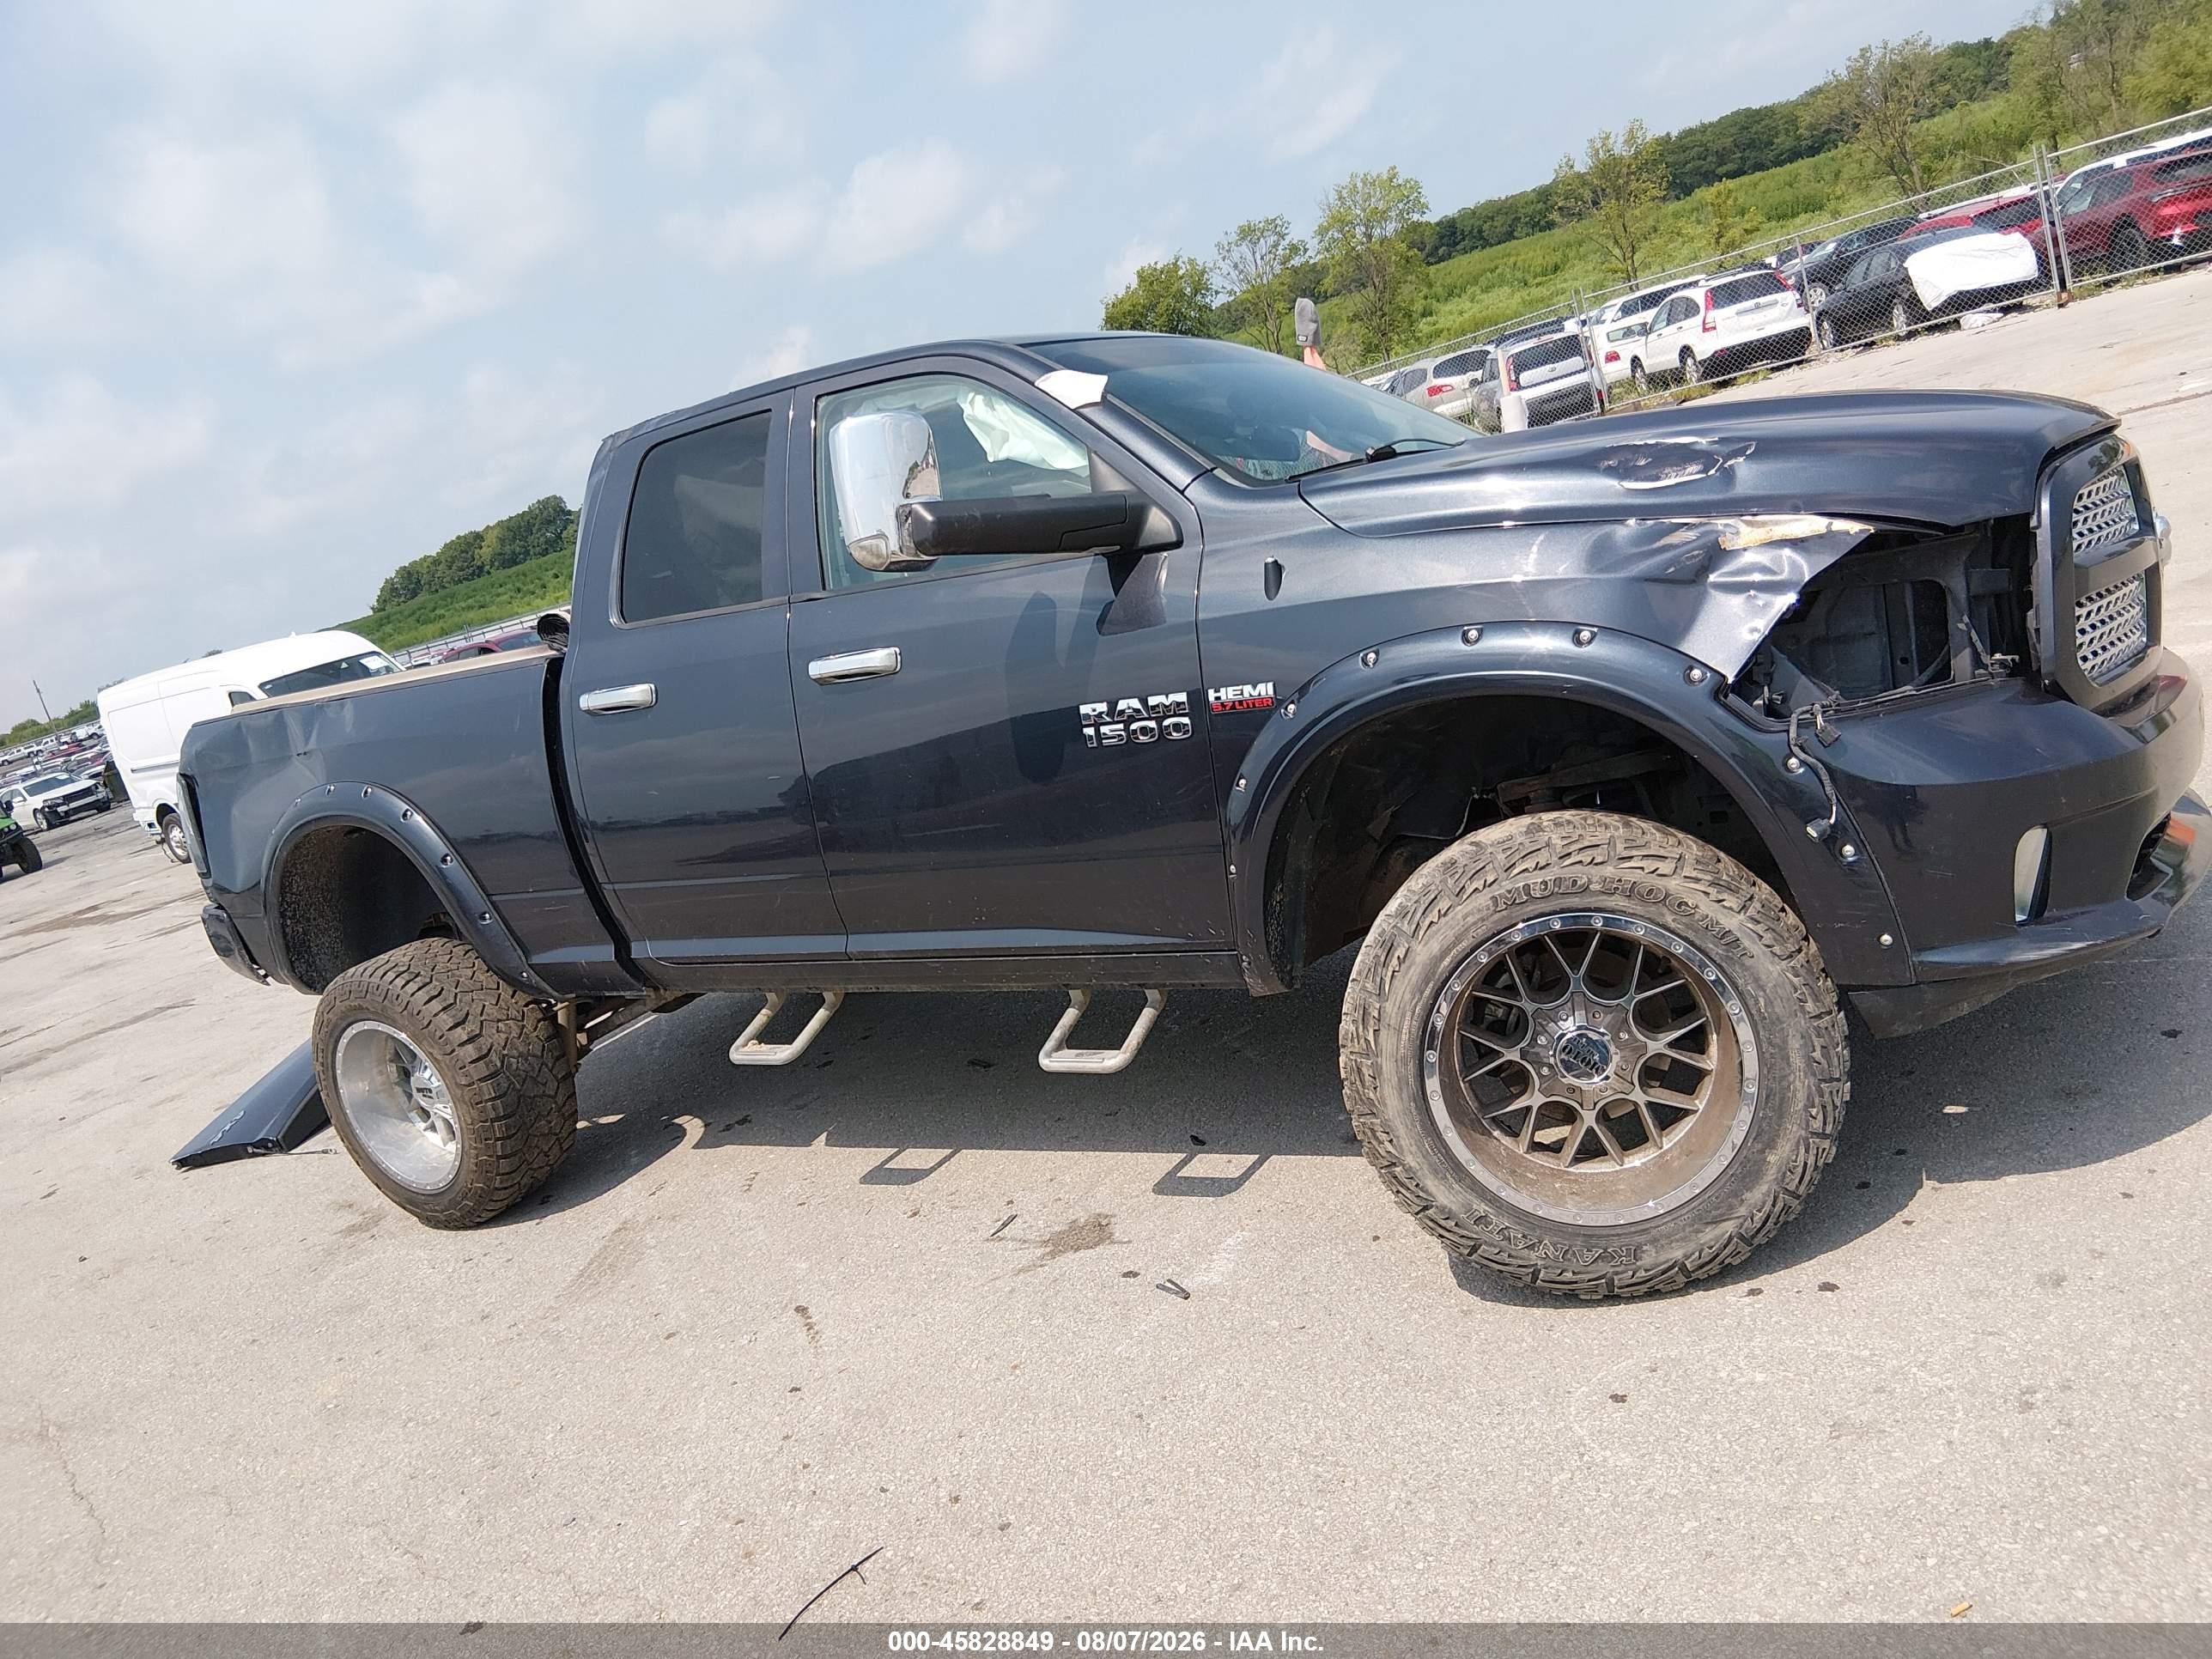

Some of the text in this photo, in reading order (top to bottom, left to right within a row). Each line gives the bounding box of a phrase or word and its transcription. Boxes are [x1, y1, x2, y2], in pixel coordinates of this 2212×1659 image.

[1079, 692, 1189, 725] RAM
[1207, 682, 1274, 702] HEMI
[1212, 698, 1273, 712] 5.7 LITER
[1083, 716, 1192, 748] 1500
[1493, 874, 1754, 959] MUD HOG M/T
[1562, 1043, 1607, 1076] MOTO
[1462, 1206, 1638, 1266] KANATI
